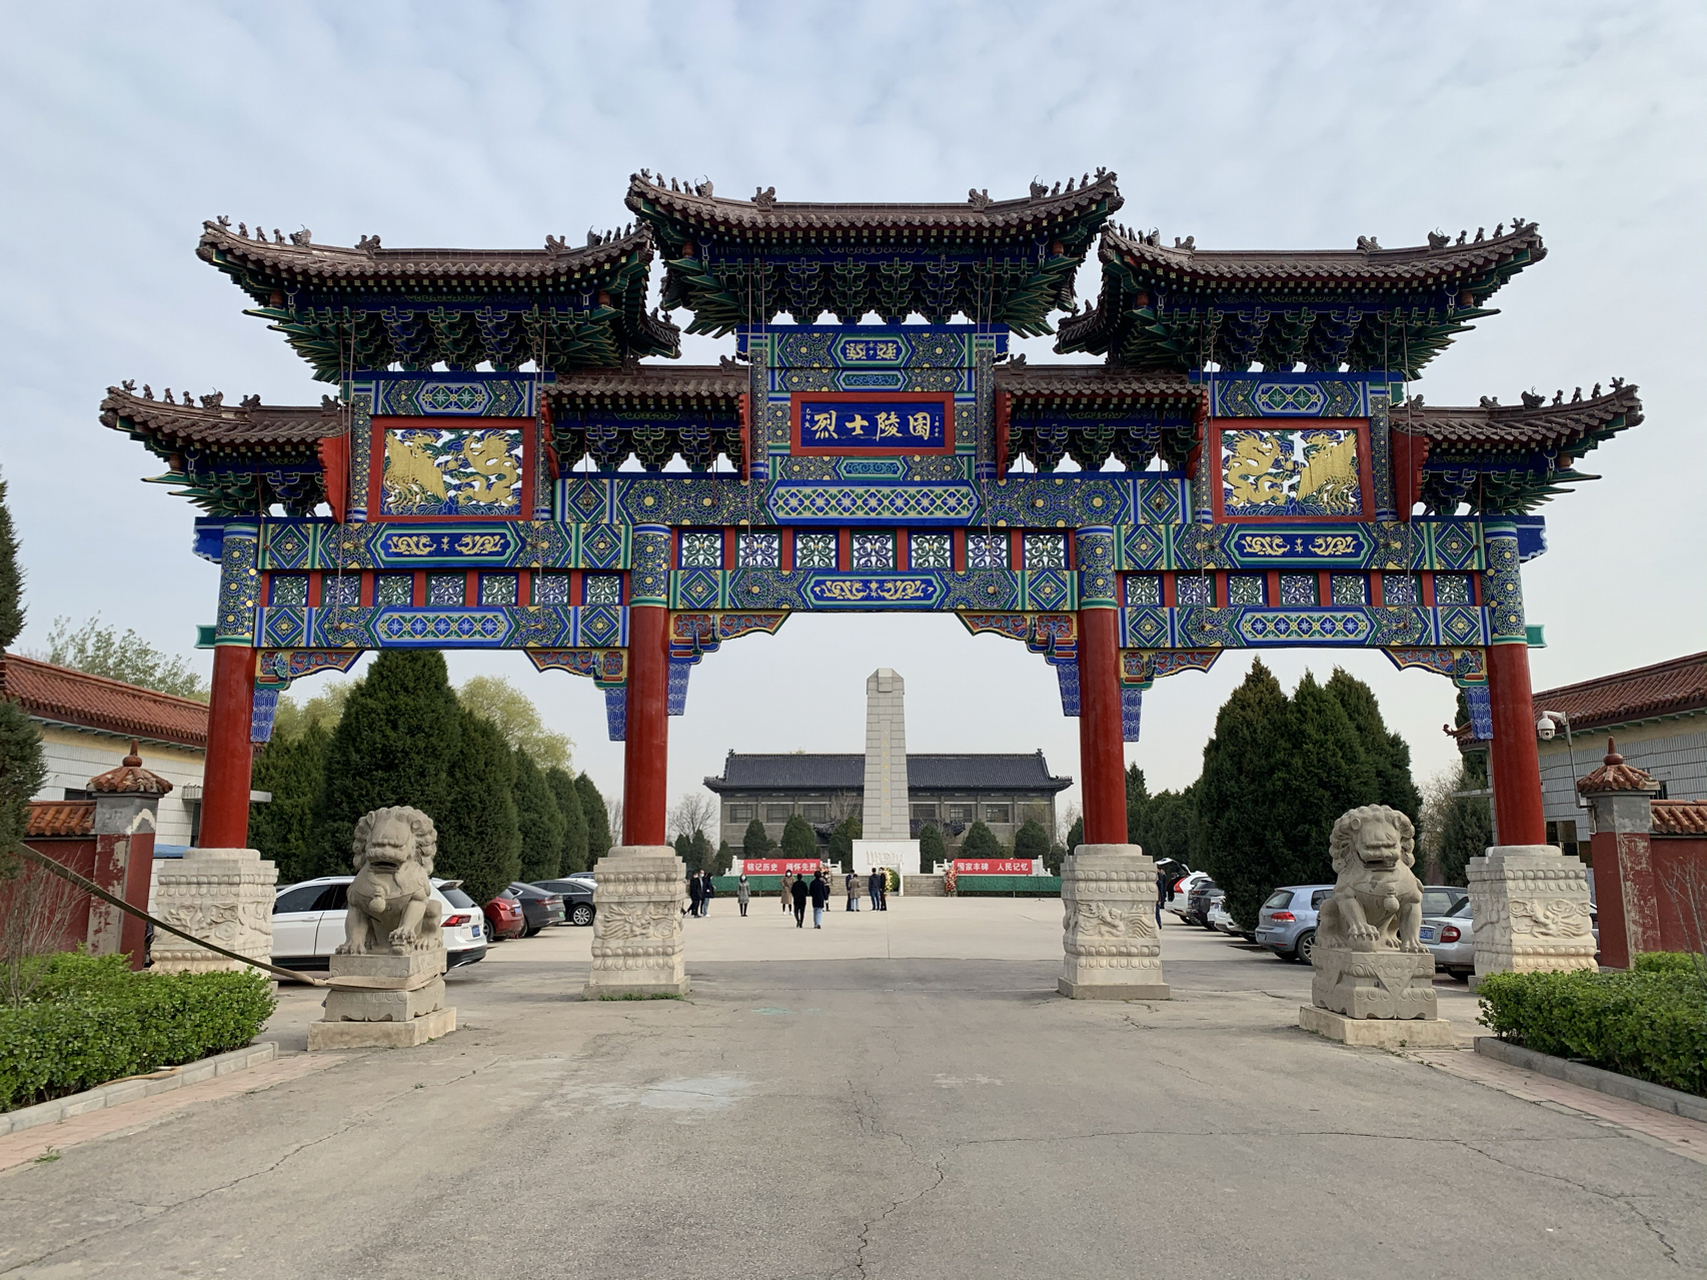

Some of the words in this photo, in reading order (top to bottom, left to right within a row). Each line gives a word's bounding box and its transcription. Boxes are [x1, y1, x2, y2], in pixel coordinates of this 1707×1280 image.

[747, 863, 778, 872] 铭记历史
[957, 862, 989, 871] 国家丰碑
[997, 862, 1029, 871] 人民记忆
